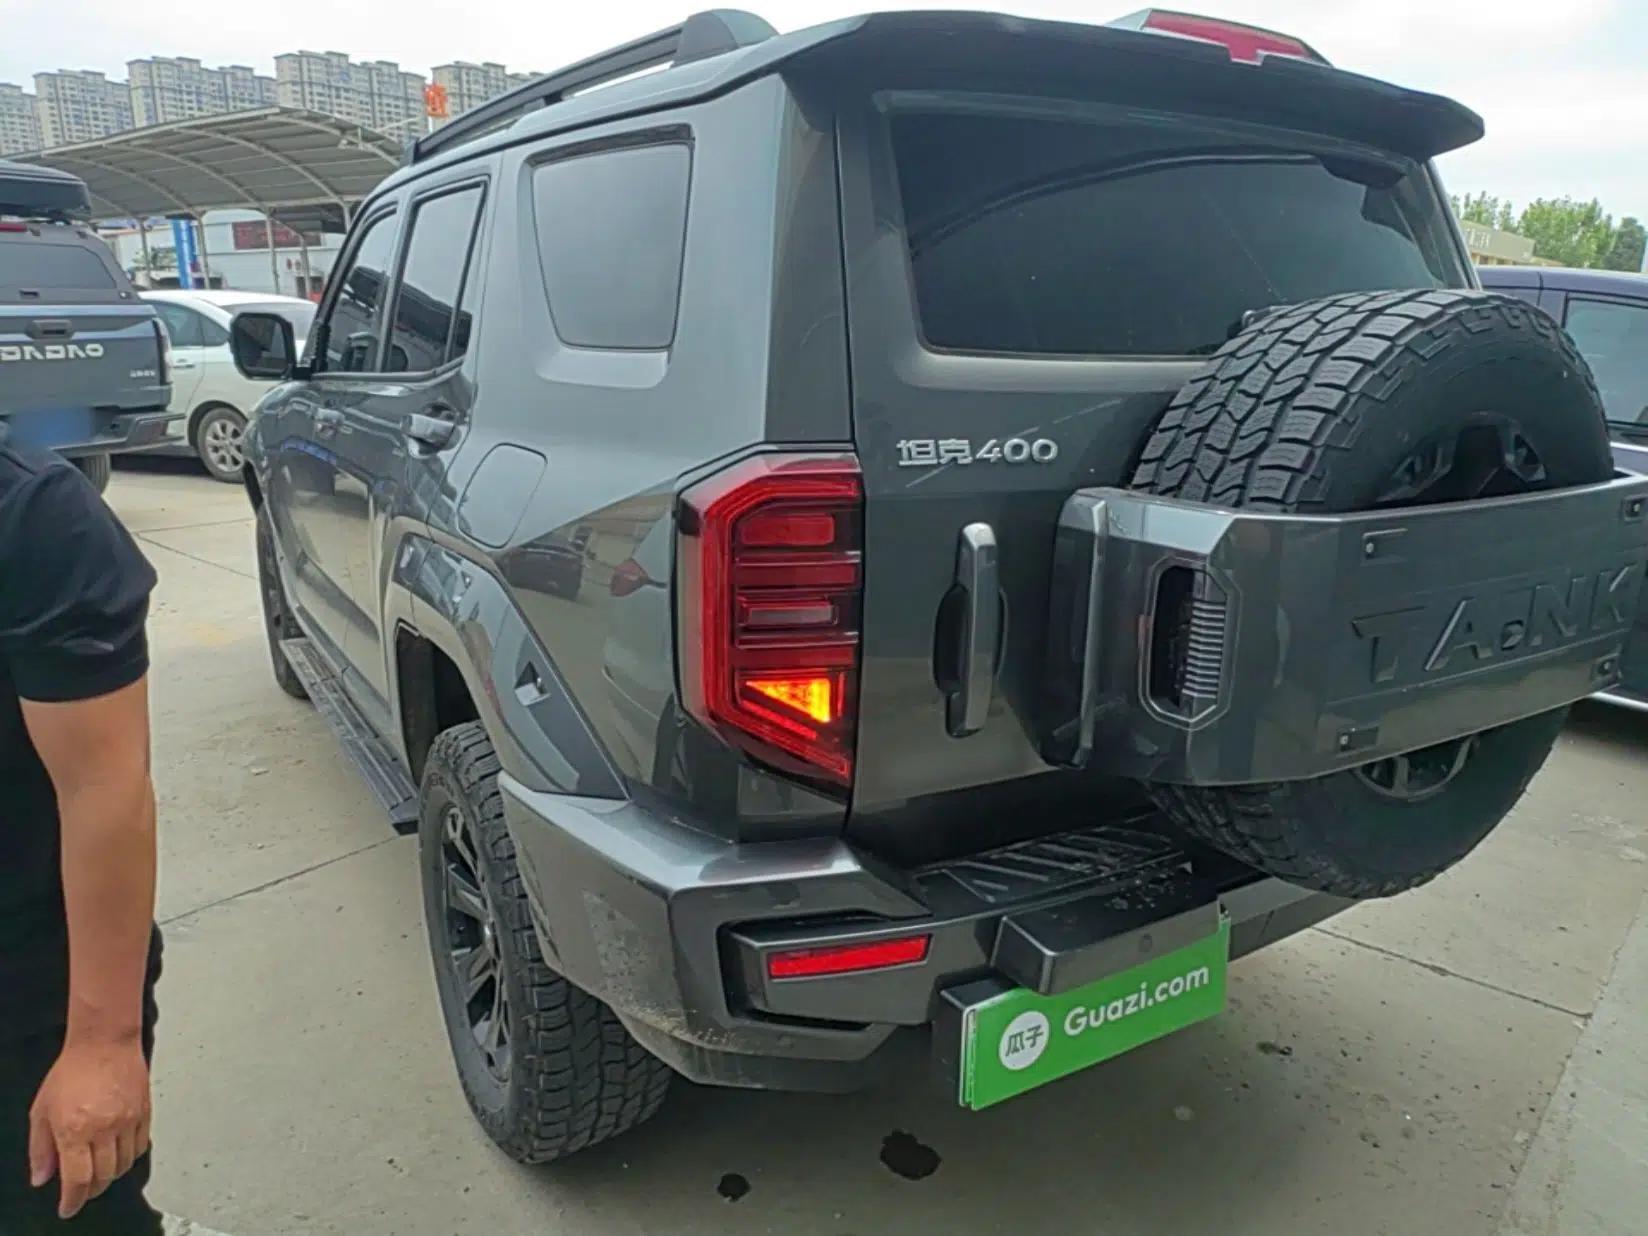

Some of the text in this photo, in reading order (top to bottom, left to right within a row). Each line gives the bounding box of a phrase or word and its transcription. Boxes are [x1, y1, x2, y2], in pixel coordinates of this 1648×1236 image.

[896, 438, 1058, 466] 坦克400
[1351, 563, 1638, 682] TANK
[1064, 966, 1209, 1036] Guazi.com
[1005, 1025, 1044, 1056] 瓜子
